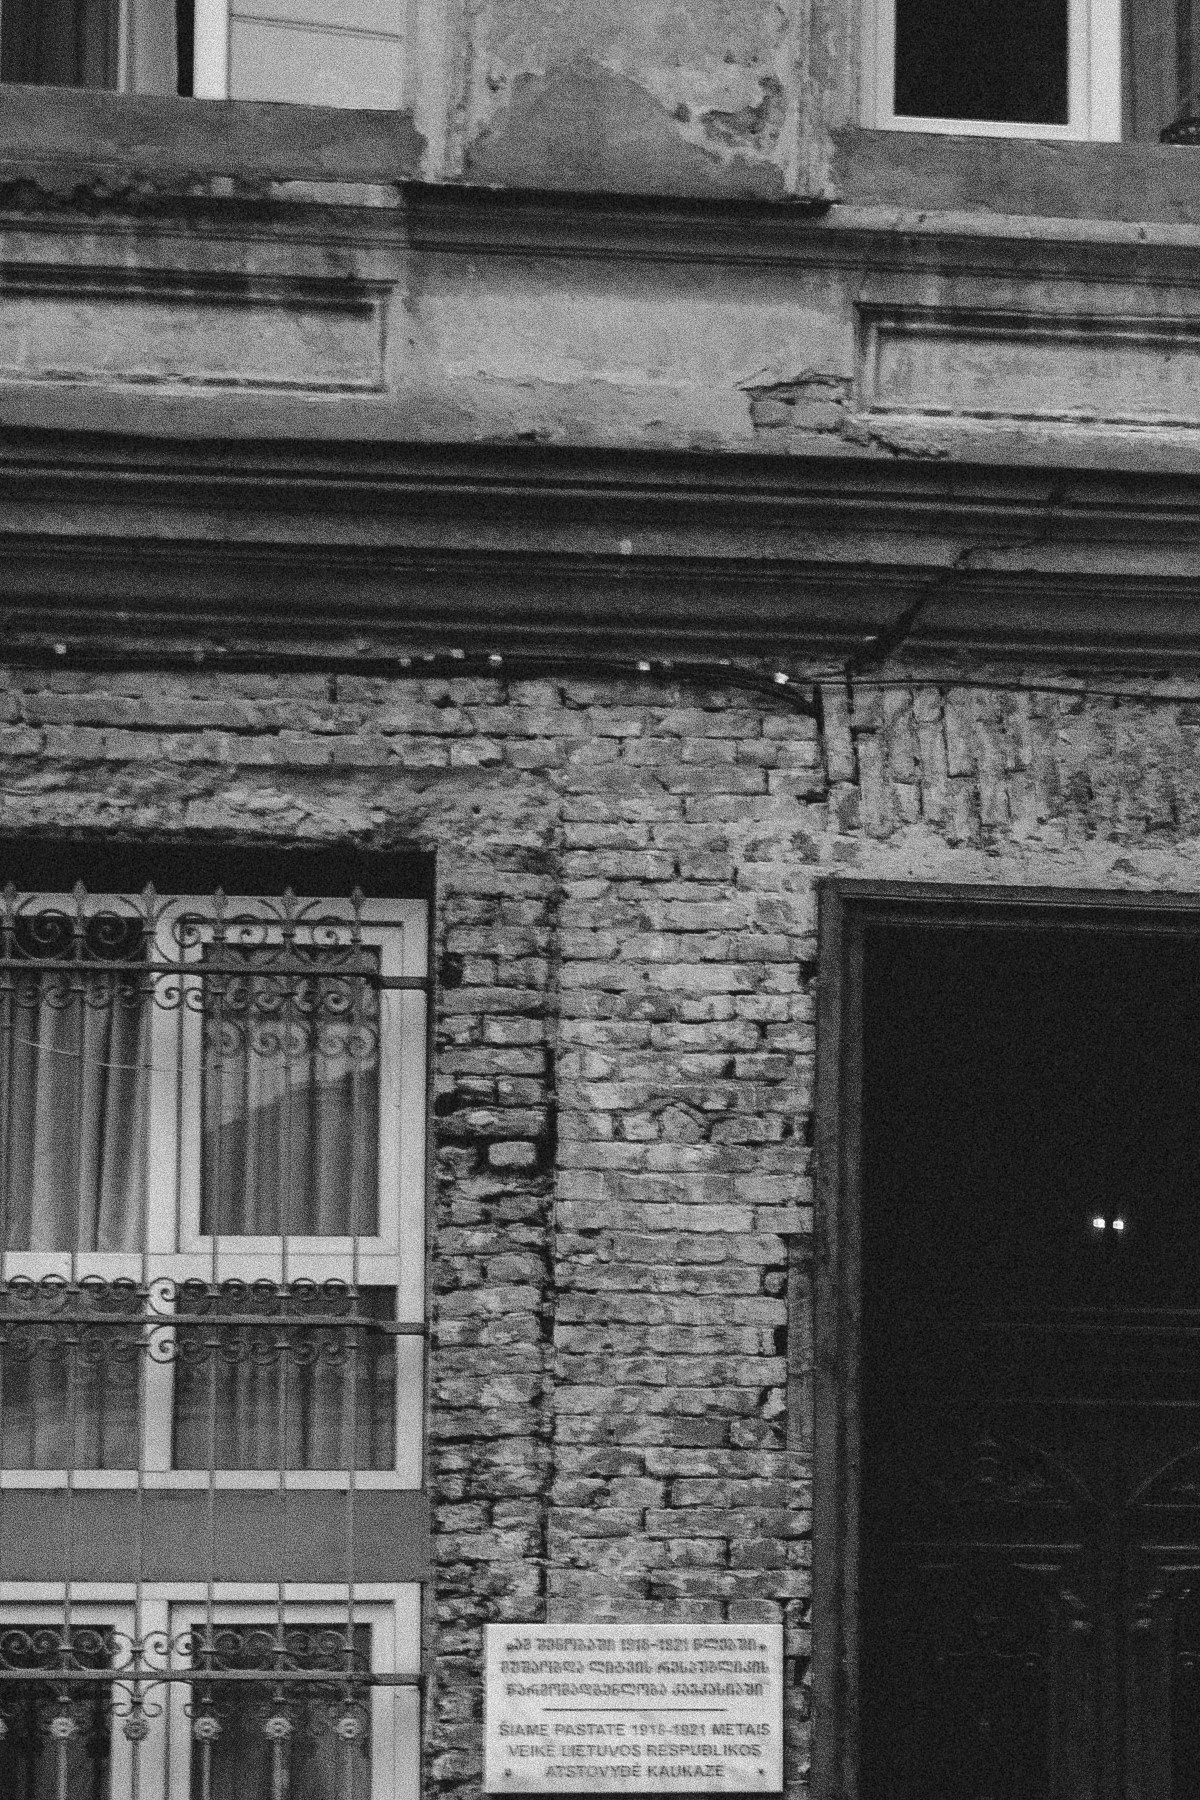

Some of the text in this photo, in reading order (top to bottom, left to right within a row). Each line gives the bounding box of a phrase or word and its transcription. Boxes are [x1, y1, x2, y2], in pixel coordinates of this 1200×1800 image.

[554, 1723, 626, 1736] PASTATE
[711, 1722, 771, 1736] METAIS
[561, 1744, 642, 1758] LIETUVOS
[646, 1744, 763, 1757] RESPUBLIKOS
